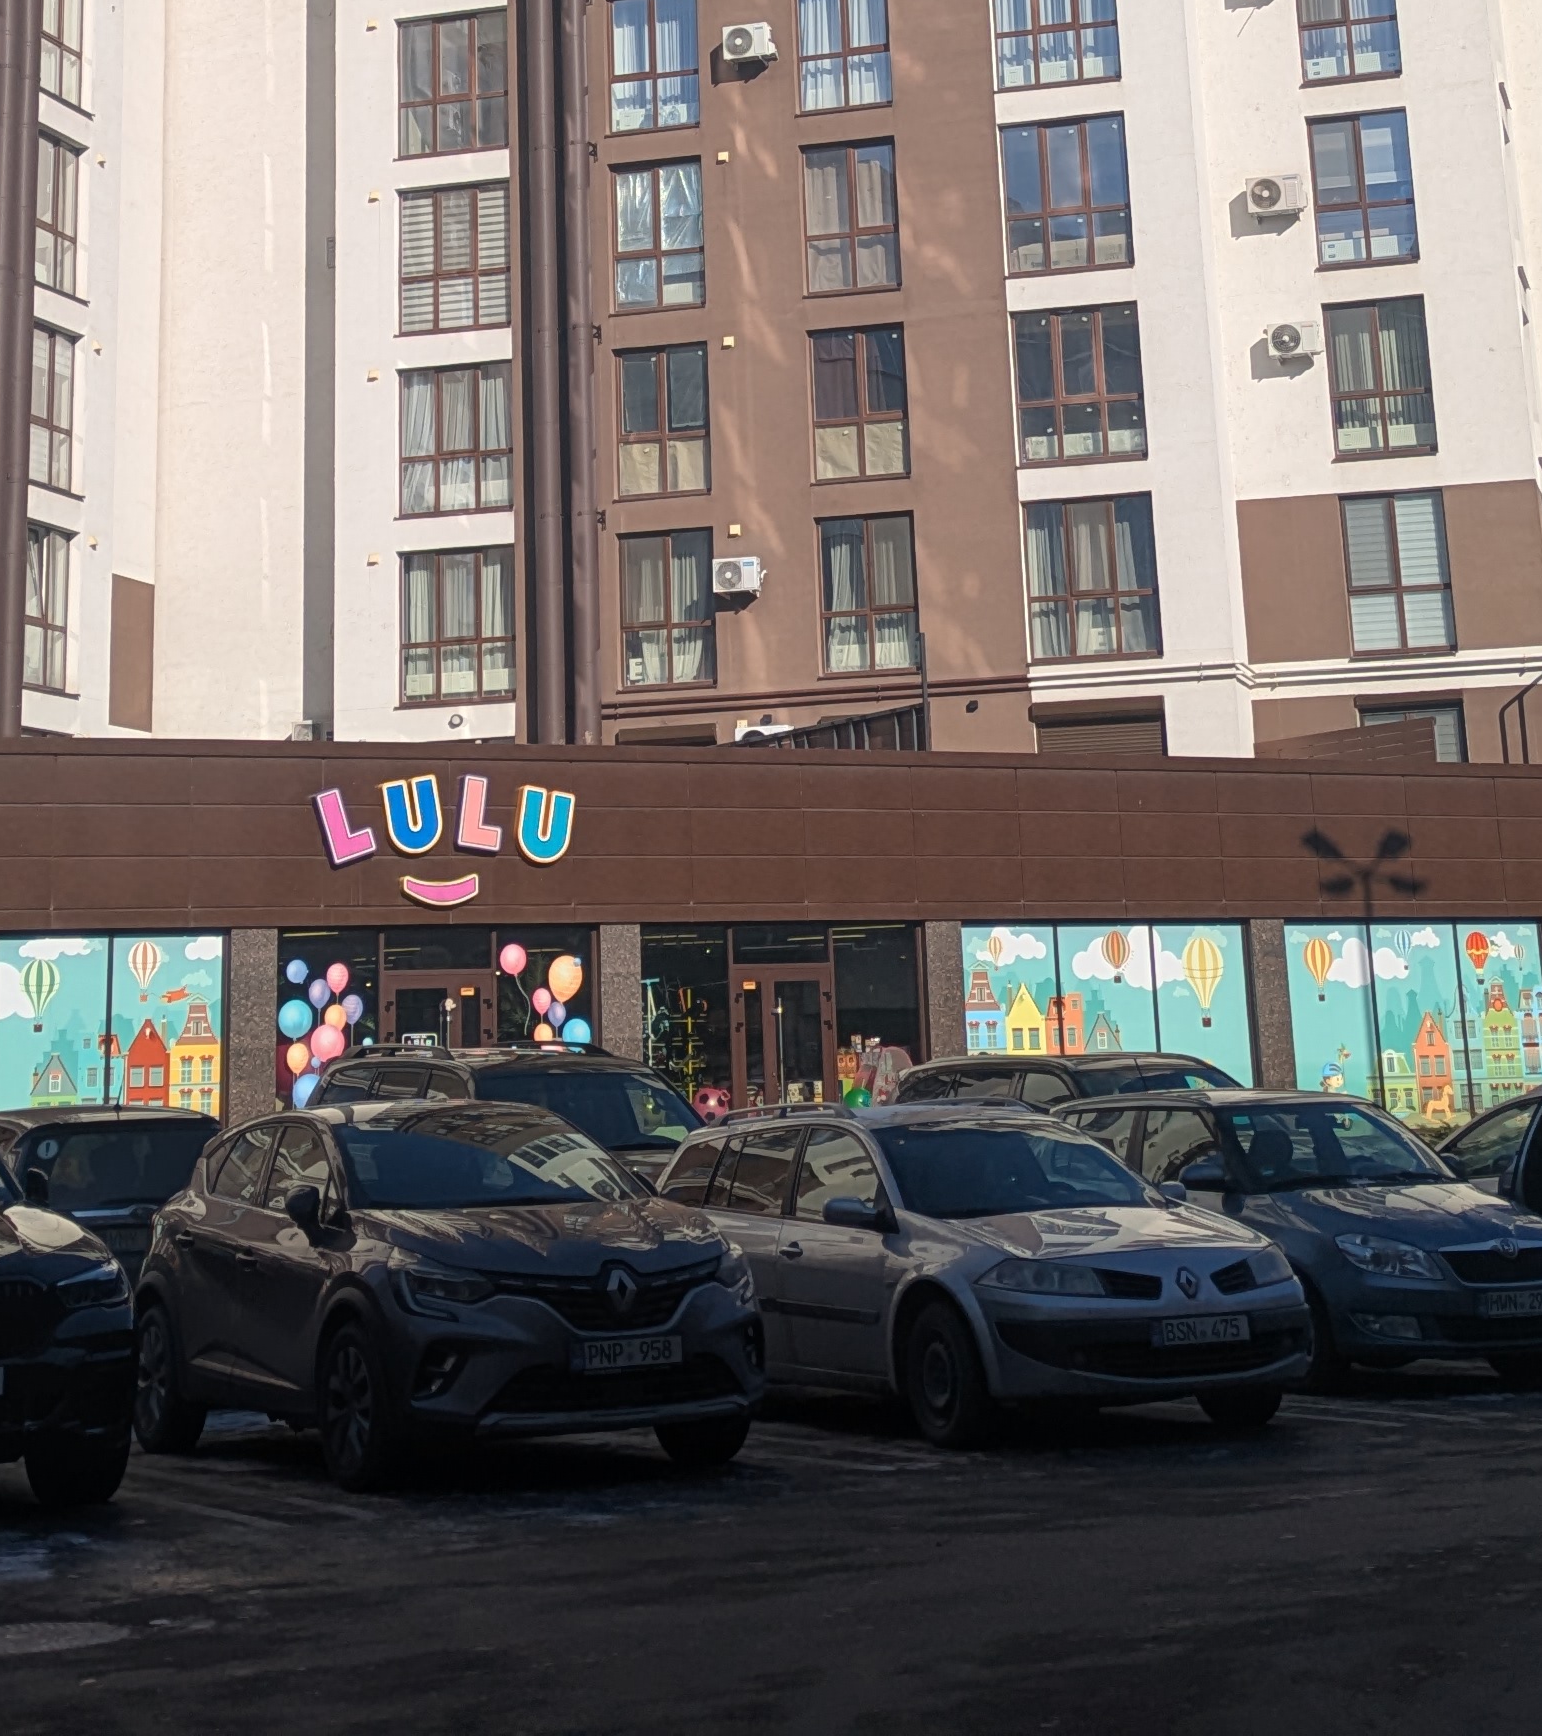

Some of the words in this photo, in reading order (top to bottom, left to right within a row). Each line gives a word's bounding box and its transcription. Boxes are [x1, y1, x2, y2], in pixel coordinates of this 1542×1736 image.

[315, 774, 576, 865] LULU
[1164, 1320, 1198, 1342] BSN
[1211, 1317, 1240, 1338] 475
[587, 1342, 624, 1366] PNP
[639, 1339, 672, 1361] 958
